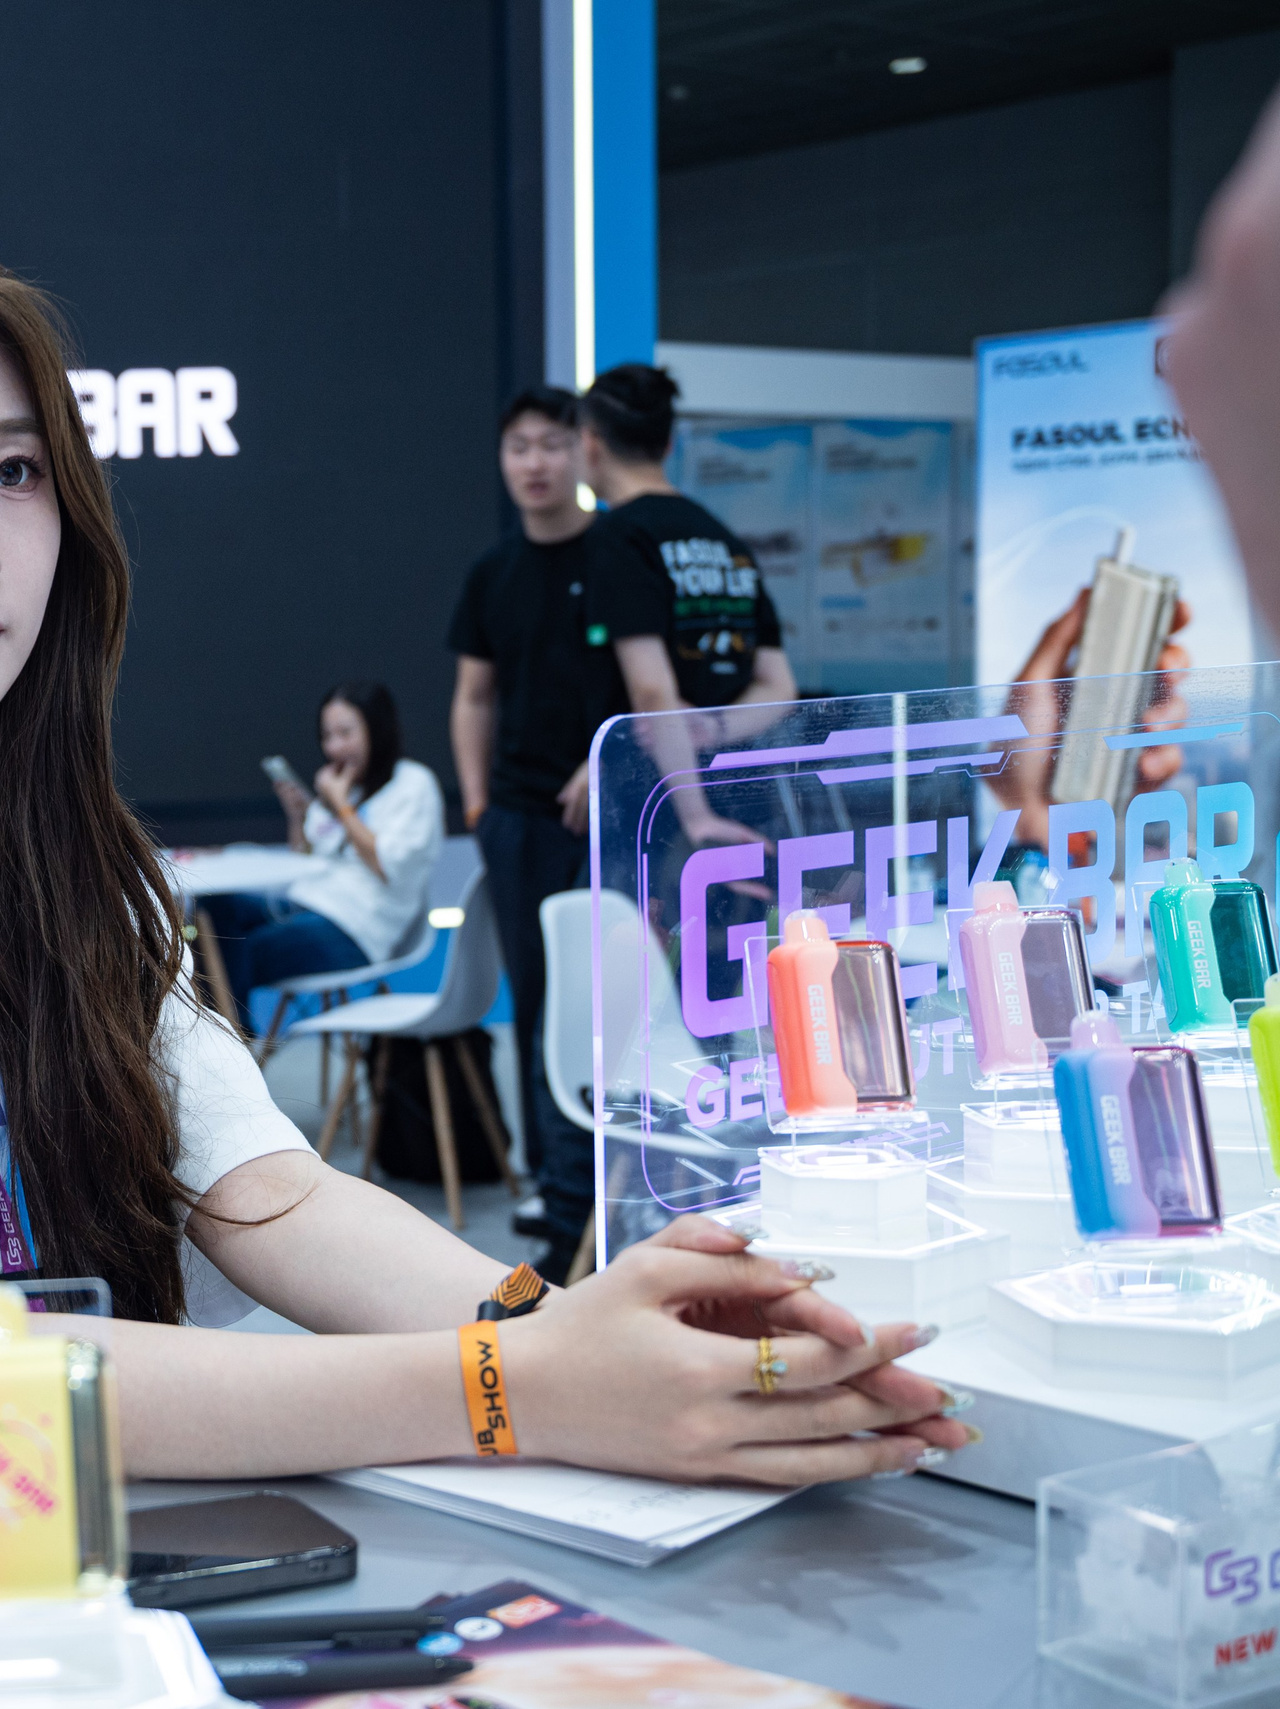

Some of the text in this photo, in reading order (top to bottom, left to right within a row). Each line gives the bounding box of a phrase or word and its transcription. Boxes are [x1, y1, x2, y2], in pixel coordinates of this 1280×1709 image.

[67, 366, 240, 460] BAR
[1048, 781, 1255, 966] BAR
[998, 951, 1023, 1026] GEEK BAR
[1187, 920, 1212, 989] GEEK BAR
[807, 984, 833, 1065] GEEK BAR
[1100, 1094, 1132, 1185] GEEK BAR
[477, 1340, 507, 1430] SHOW
[1215, 1626, 1277, 1668] NEW
